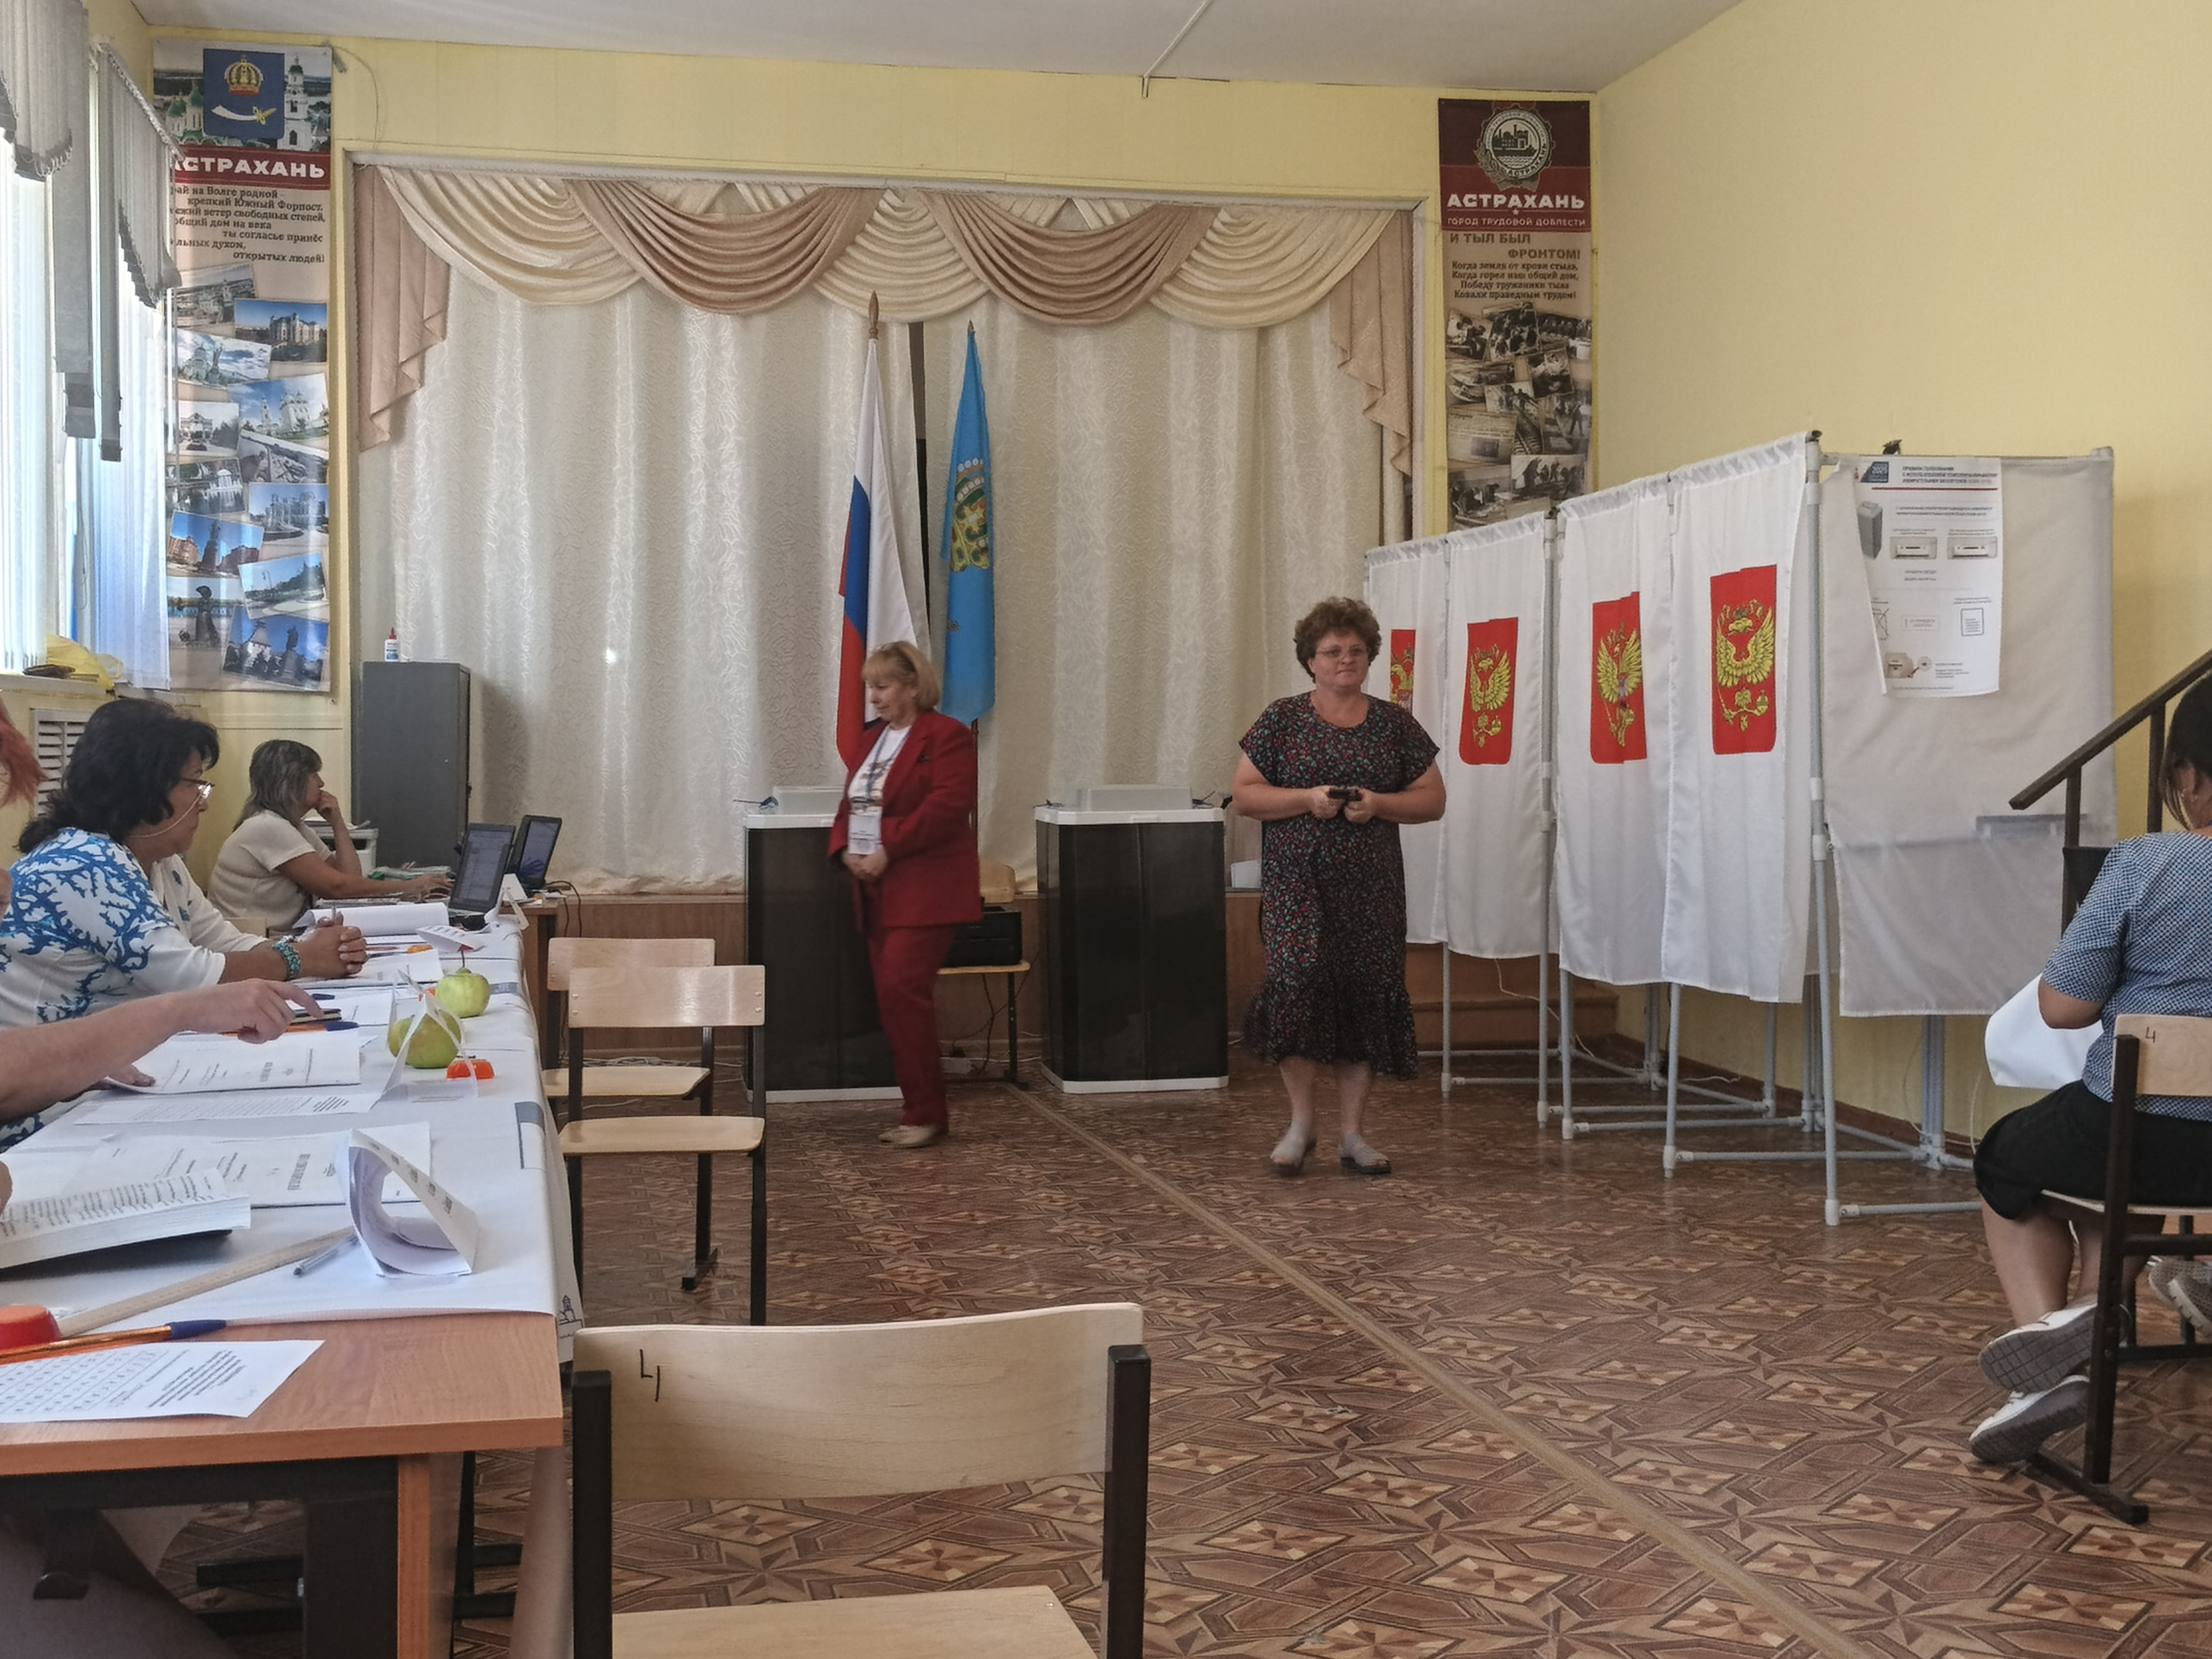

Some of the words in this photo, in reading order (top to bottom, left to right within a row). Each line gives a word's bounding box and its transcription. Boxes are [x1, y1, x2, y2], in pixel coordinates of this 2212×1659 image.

[207, 187, 237, 197] Волге
[239, 190, 278, 201] родной
[187, 198, 231, 209] крепкий
[234, 199, 274, 208] Южный
[1447, 194, 1585, 208] АСТРАХАНЬ
[204, 210, 231, 219] ветер
[234, 210, 287, 222] свободных
[290, 214, 325, 223] степей,
[1482, 218, 1532, 226] ТРУДОВОЙ
[239, 232, 285, 241] согласье
[1451, 233, 1459, 243] И
[1464, 233, 1495, 244] ТЫЛ
[1499, 234, 1531, 244] БЫЛ
[212, 241, 246, 250] духом,
[233, 251, 286, 261] открытых
[1508, 249, 1581, 260] ФРОНТОМ!
[1452, 261, 1477, 270] Когда
[1522, 263, 1549, 271] крови
[1452, 271, 1477, 280] Когда
[1480, 273, 1504, 281] горел
[1528, 272, 1558, 281] общий
[1461, 280, 1493, 290] Победу
[1454, 290, 1488, 299] Ковали
[1489, 292, 1540, 300] праведным
[1543, 292, 1576, 300] трудом!
[2145, 1027, 2156, 1043] 4
[639, 1349, 660, 1402] 4
